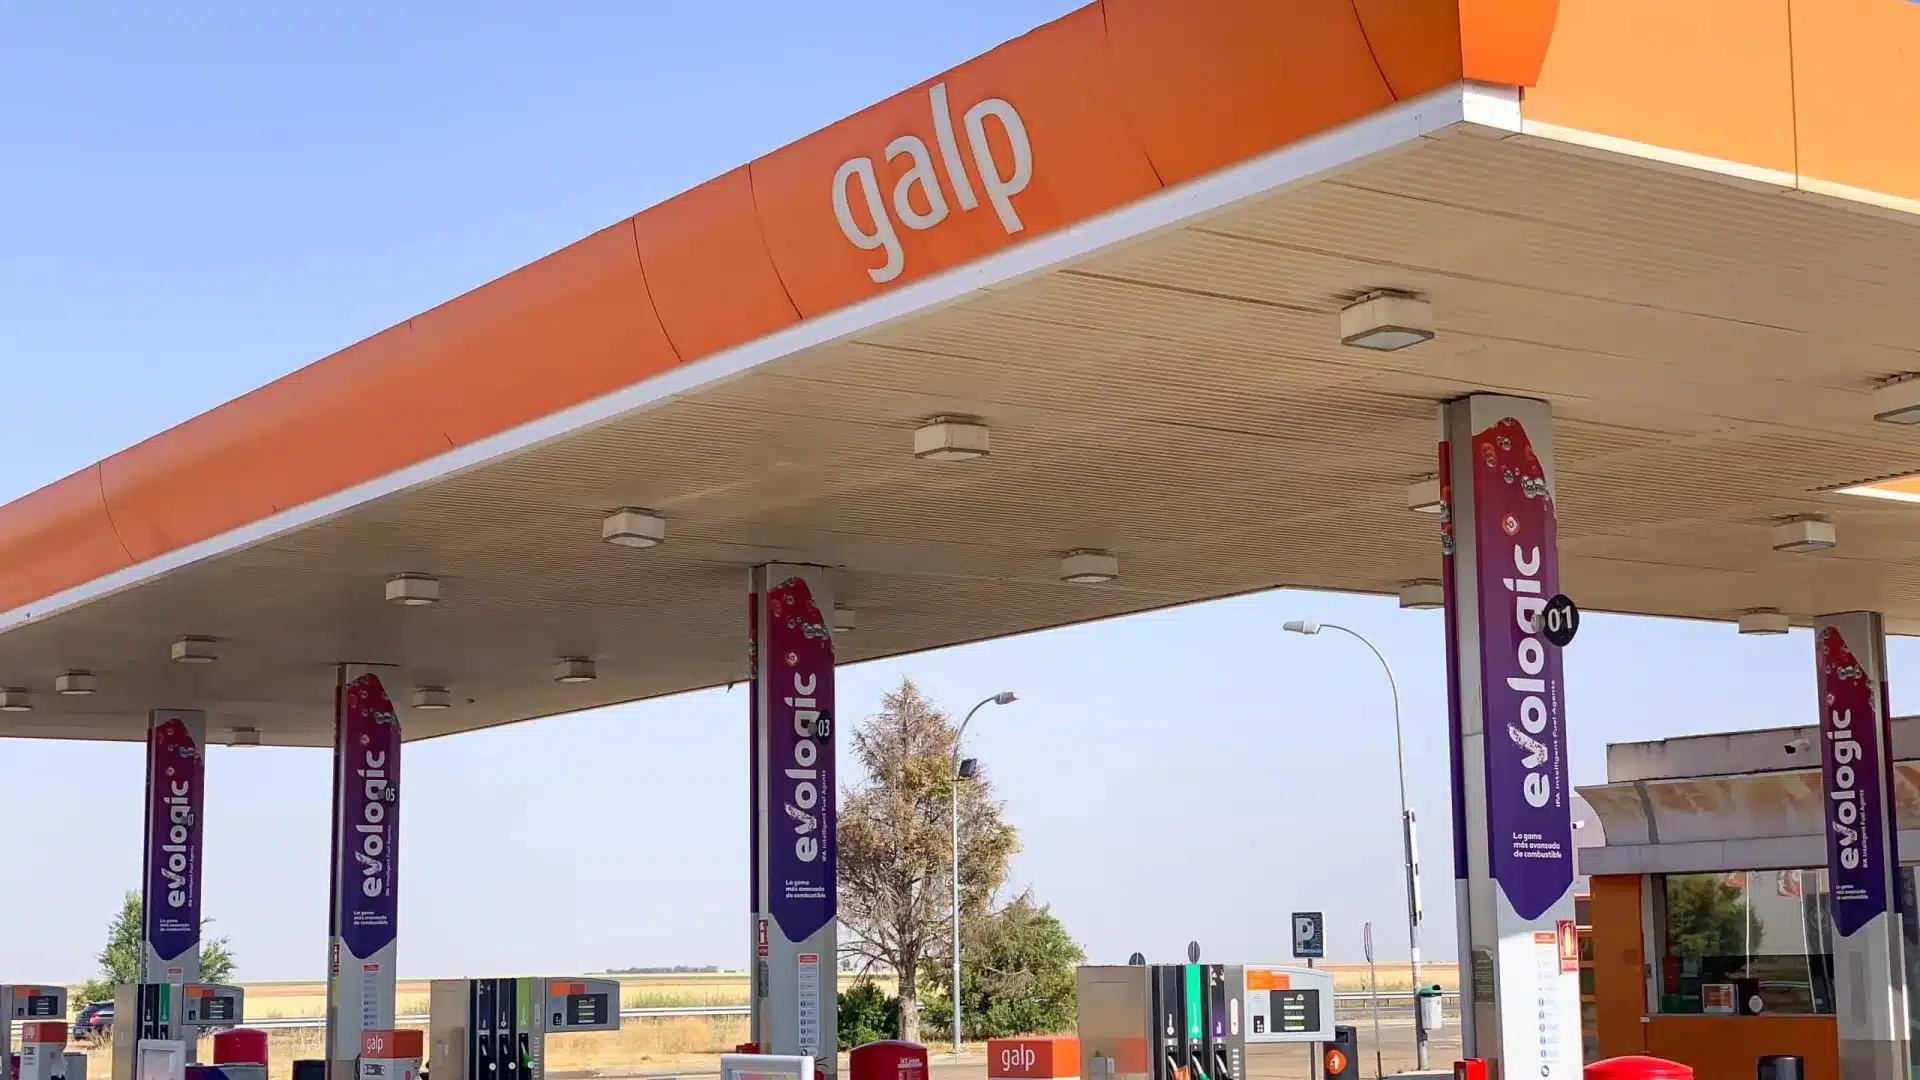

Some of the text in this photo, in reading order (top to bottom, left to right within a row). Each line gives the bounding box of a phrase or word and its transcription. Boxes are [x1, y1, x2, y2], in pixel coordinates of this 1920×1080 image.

[832, 81, 1033, 283] galp
[1547, 605, 1573, 632] 01
[1503, 544, 1551, 808] evologic
[818, 719, 830, 737] 03
[784, 672, 820, 862] evologic
[385, 787, 396, 802] 05
[1827, 708, 1862, 869] evologic
[1513, 841, 1528, 849] más
[1523, 833, 1542, 841] gama
[1513, 850, 1562, 858] de combustible
[366, 1035, 384, 1054] galp
[1001, 1043, 1036, 1072] galp
